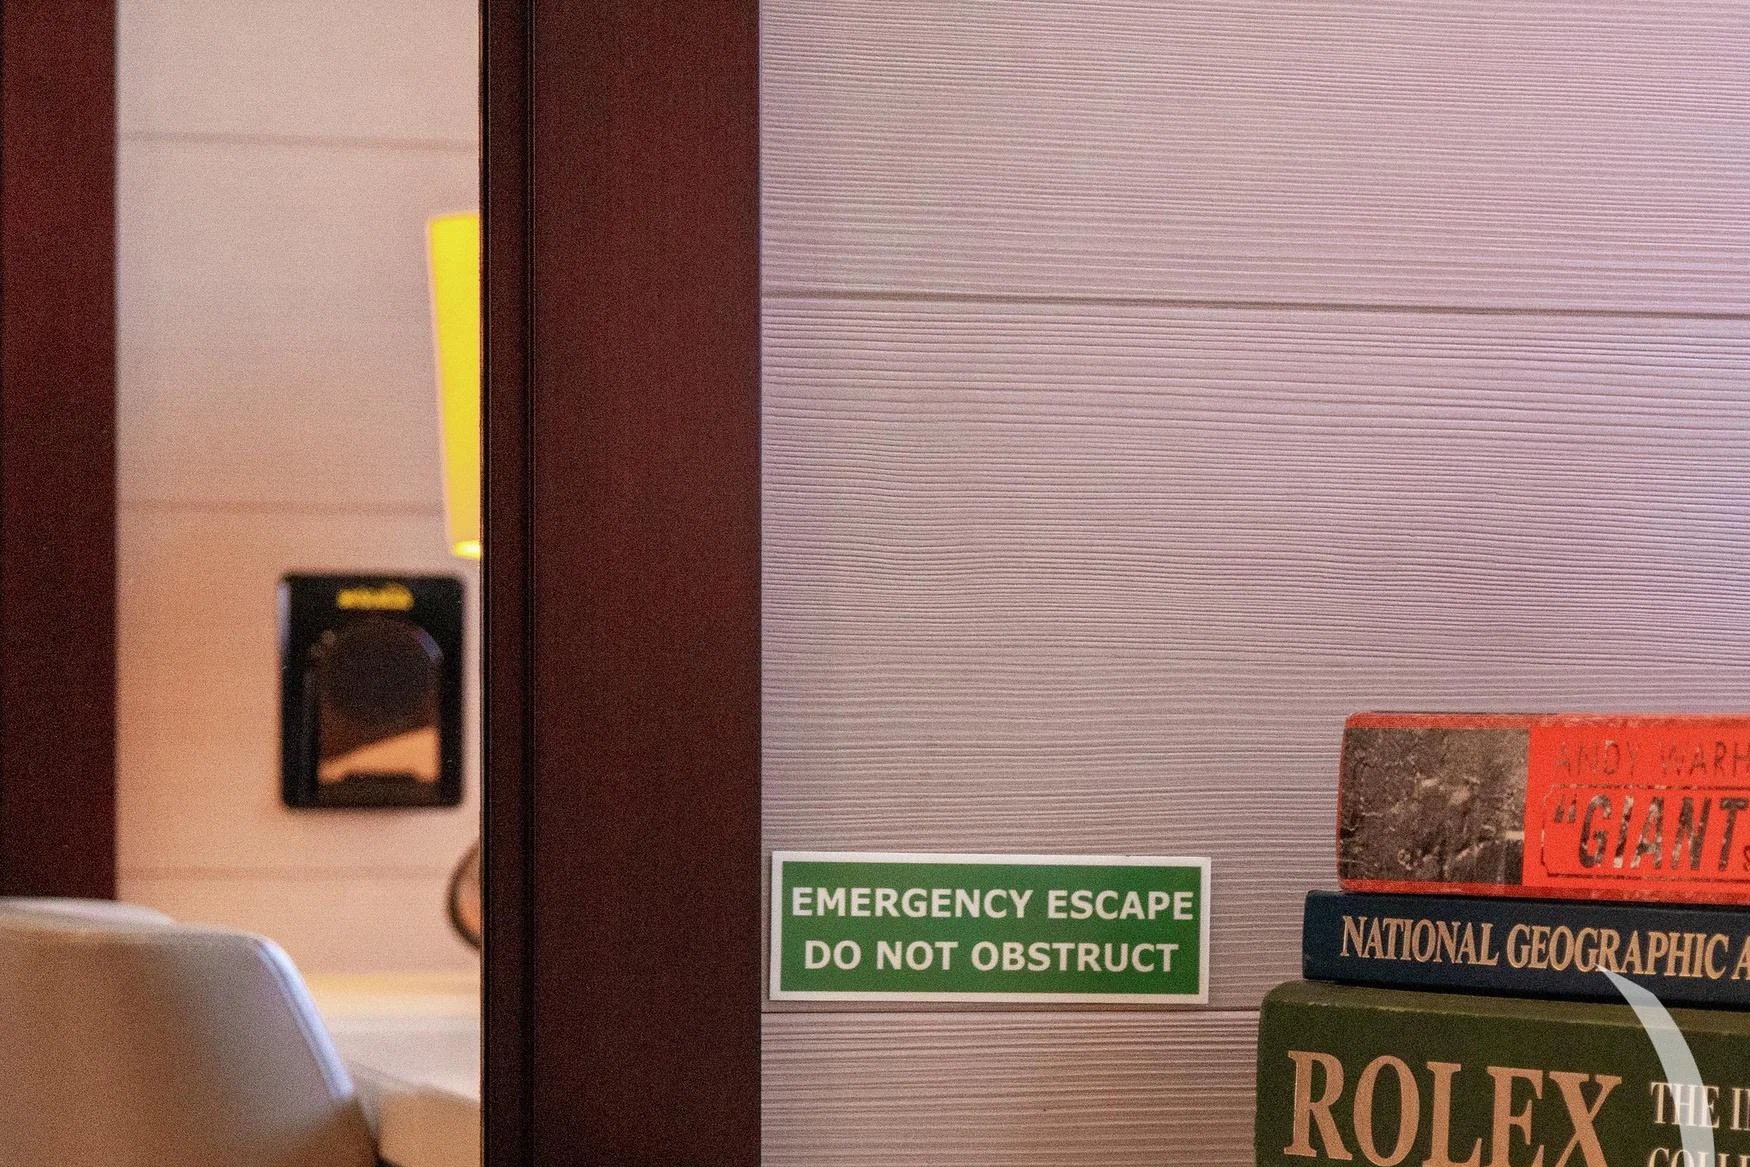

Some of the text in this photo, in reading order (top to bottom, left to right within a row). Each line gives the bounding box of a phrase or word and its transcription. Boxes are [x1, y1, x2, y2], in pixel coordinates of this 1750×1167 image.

[1553, 738, 1640, 777] ANDY
[792, 887, 1194, 920] EMERGENCY ESCAPE
[804, 939, 1179, 972] DO NOT OBSTRUCT
[1340, 915, 1499, 966] NATIONAL
[1506, 923, 1729, 981] GEOGRAPHIC
[1650, 1082, 1720, 1128] THE
